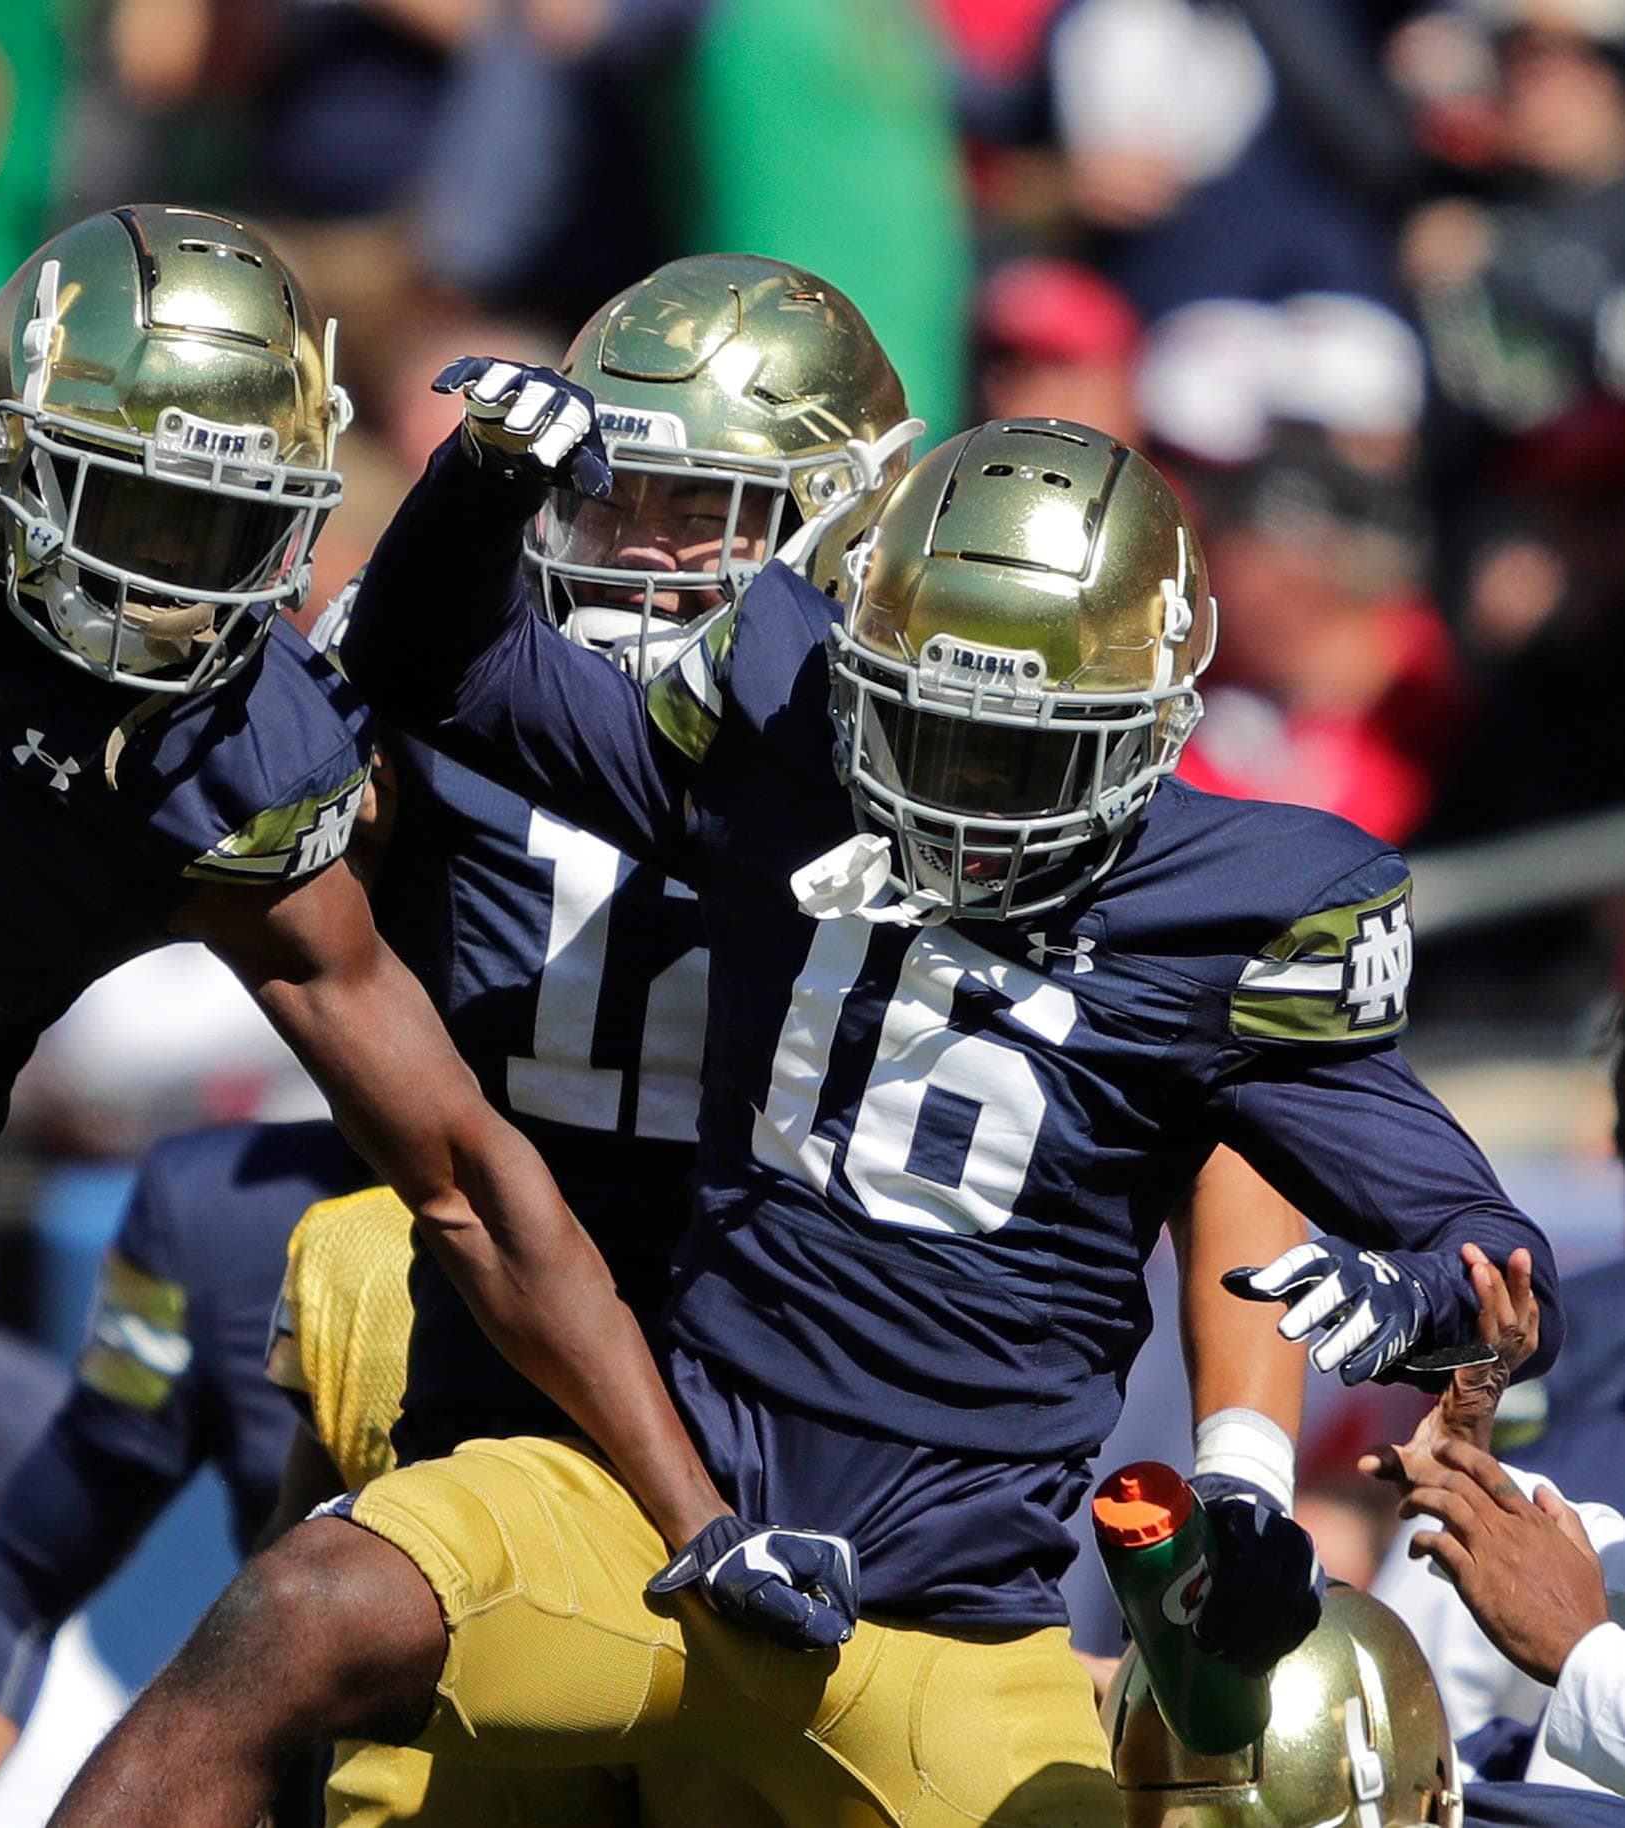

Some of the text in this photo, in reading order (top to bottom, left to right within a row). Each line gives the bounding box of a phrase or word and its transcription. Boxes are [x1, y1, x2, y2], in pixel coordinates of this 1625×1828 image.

[183, 425, 247, 453] IRISH
[952, 647, 1016, 676] IRISH
[751, 916, 1078, 1234] 16
